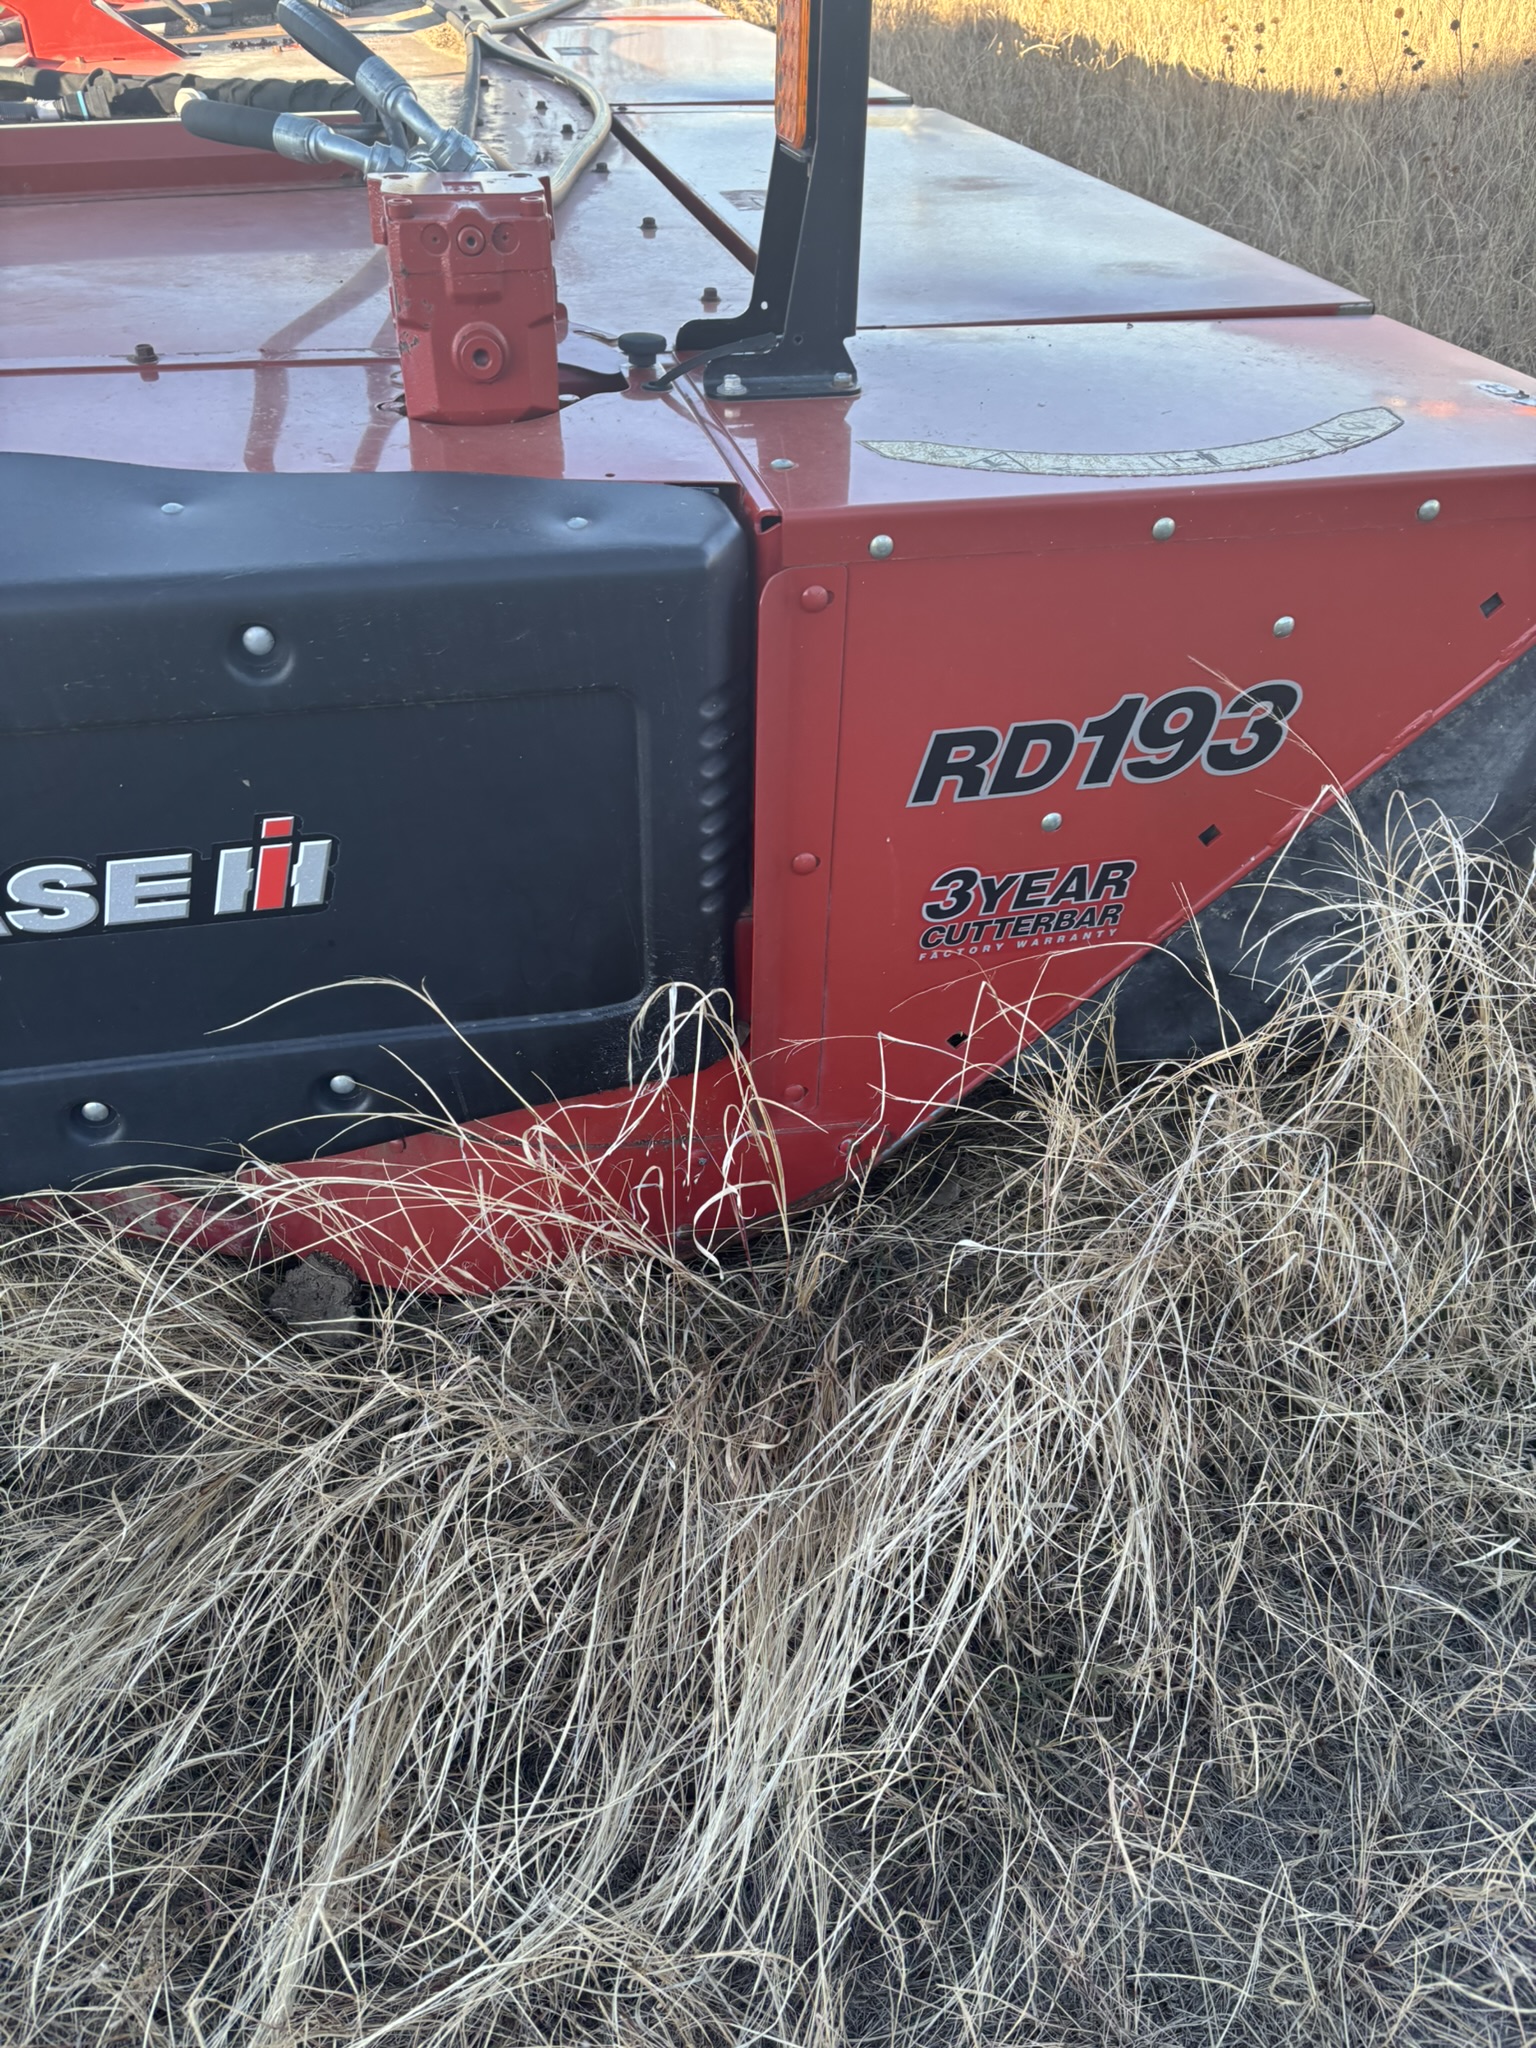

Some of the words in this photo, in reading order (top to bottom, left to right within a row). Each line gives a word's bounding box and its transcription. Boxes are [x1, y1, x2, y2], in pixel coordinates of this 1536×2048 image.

[905, 679, 1303, 808] RD193
[0, 853, 193, 937] SE
[919, 903, 1124, 949] CUTTERBAR
[918, 943, 1004, 961] FACTORY
[1016, 928, 1118, 949] WARRANTY
